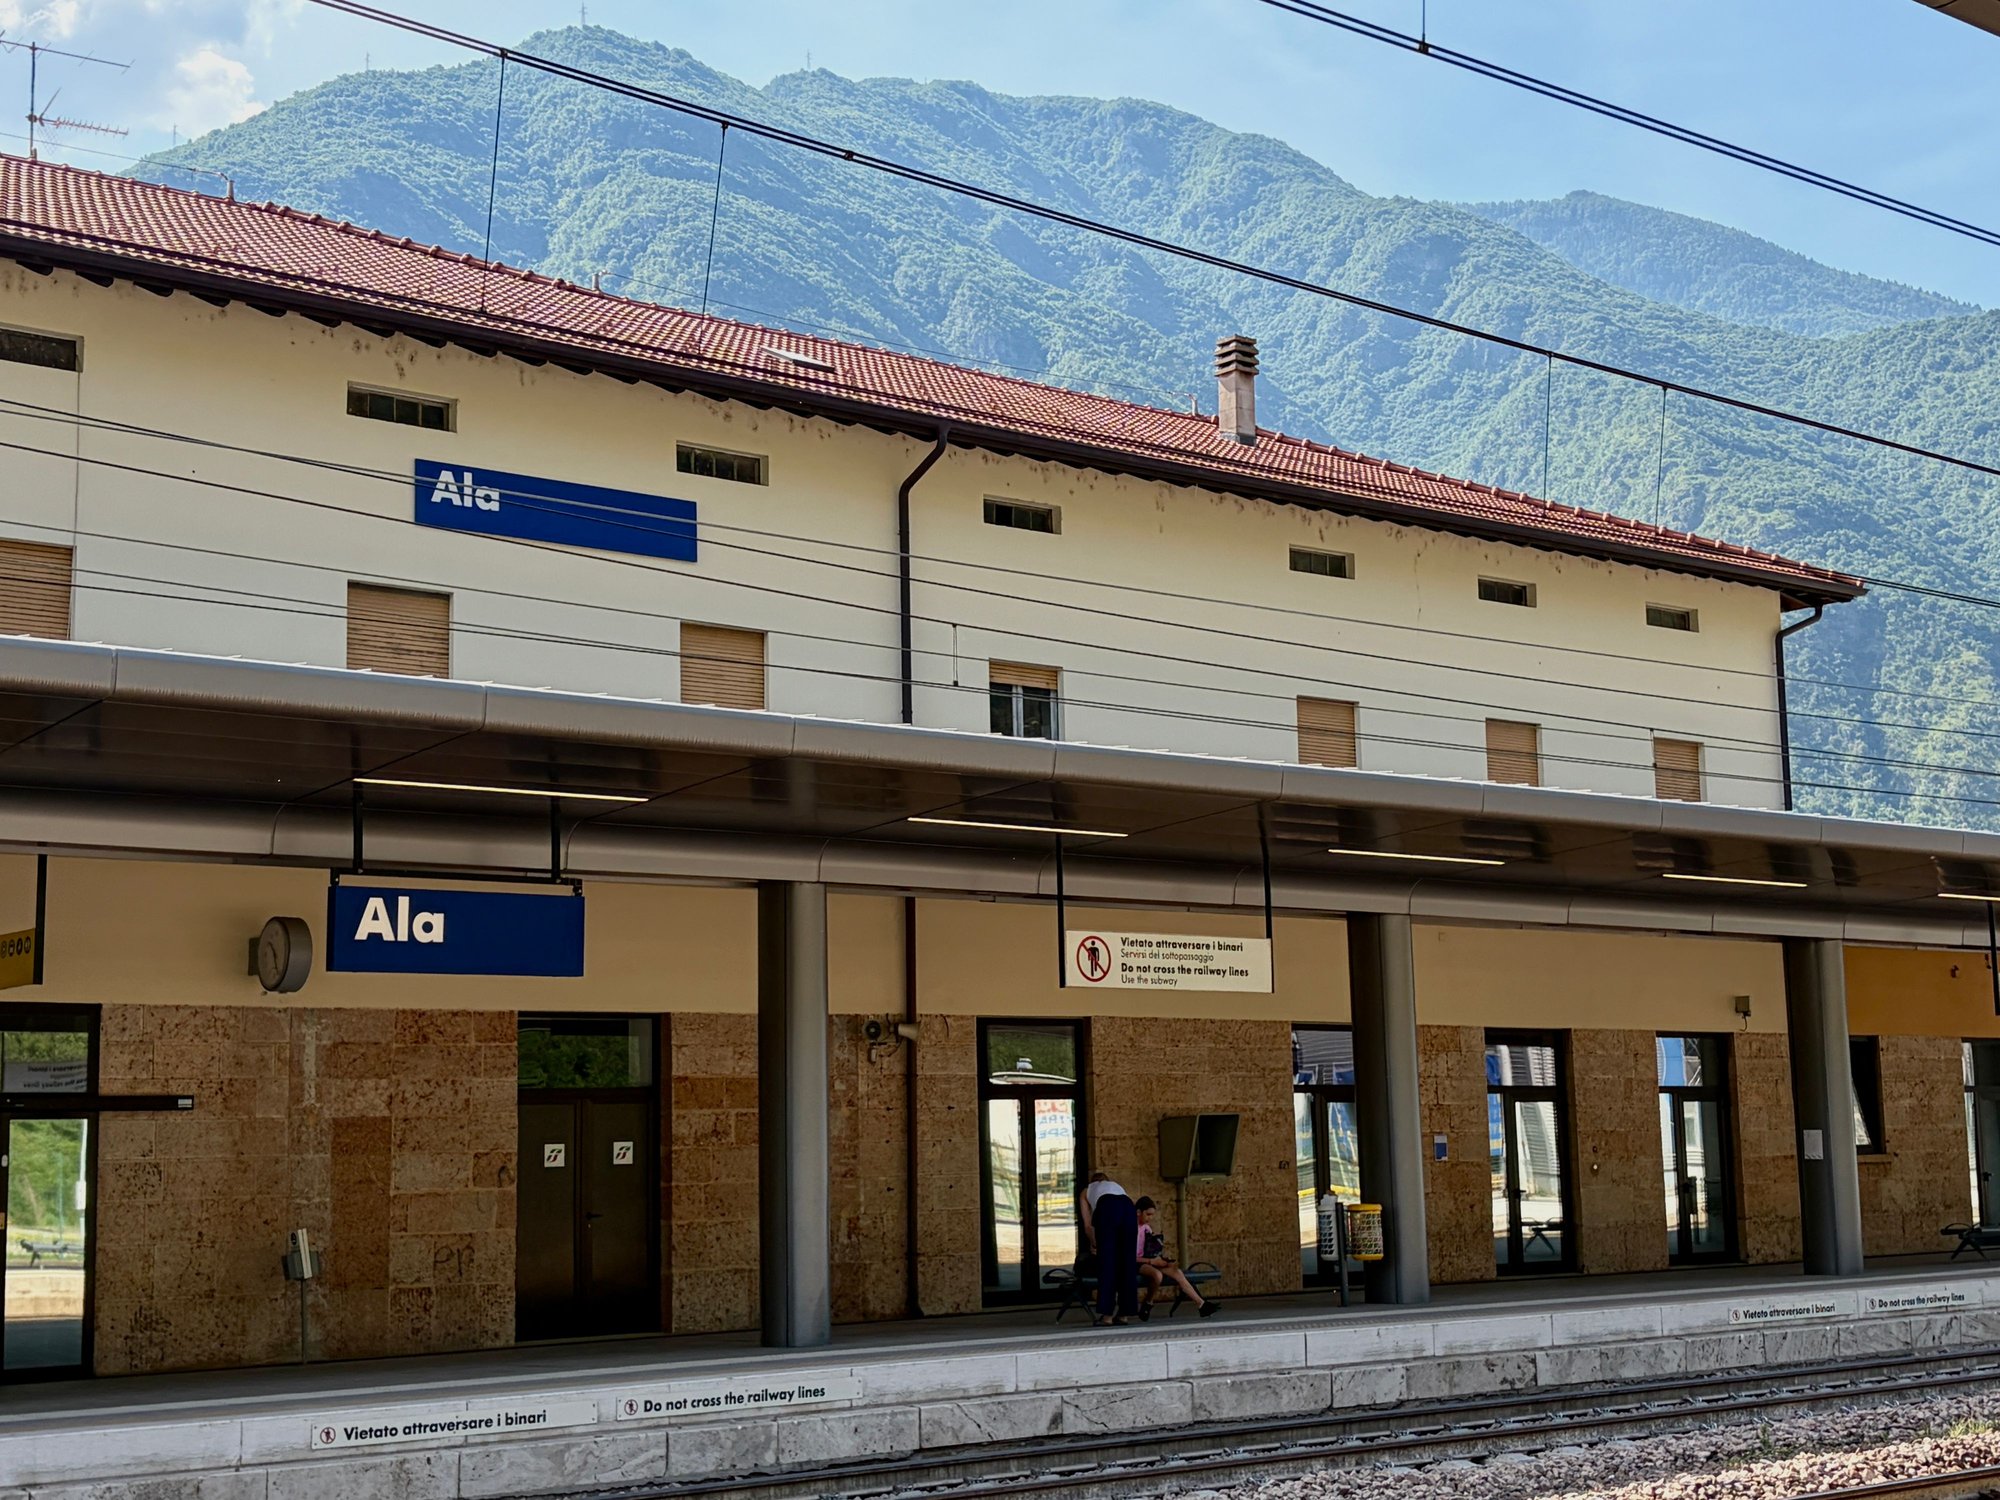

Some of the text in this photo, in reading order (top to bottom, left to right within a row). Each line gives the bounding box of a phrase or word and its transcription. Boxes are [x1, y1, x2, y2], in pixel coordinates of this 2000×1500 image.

[431, 470, 500, 511] Ala
[354, 896, 445, 943] Ala
[1121, 937, 1243, 952] Vietato attraversare i binari
[1121, 950, 1214, 963] Servirsi del sottopassaggio
[1121, 963, 1248, 977] Do not cross the railway lines
[1121, 974, 1178, 986] Use the subway
[1879, 1293, 1964, 1307] Do not cross the railway lines
[1743, 1309, 1768, 1319] Vietato
[1769, 1306, 1810, 1317] attraversare
[1816, 1303, 1835, 1313] binari
[644, 1385, 825, 1414] Do not cross the railway lines
[344, 1409, 547, 1440] Vietato attraversare i binari
